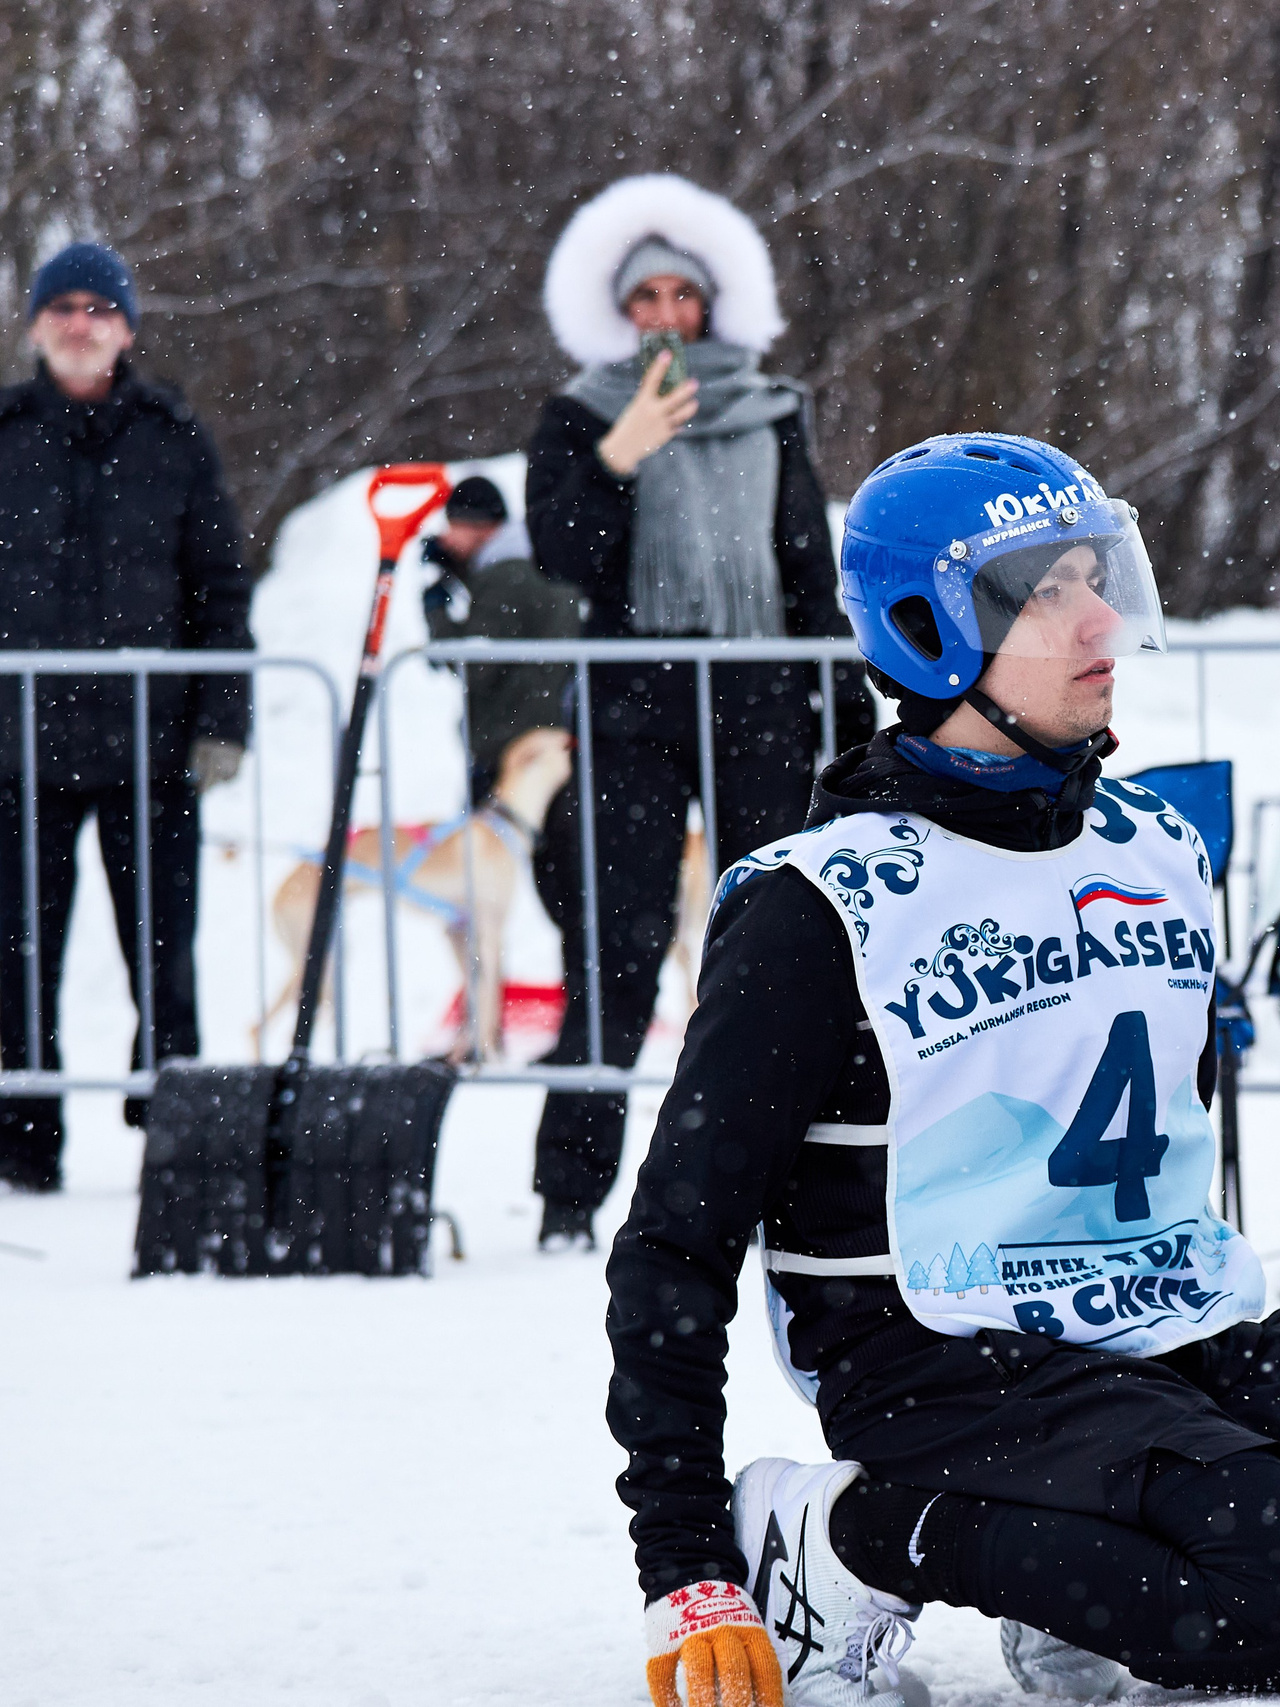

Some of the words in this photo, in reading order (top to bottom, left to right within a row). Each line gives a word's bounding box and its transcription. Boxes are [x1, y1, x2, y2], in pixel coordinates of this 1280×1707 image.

[981, 518, 1052, 547] МУРМАНСК
[917, 1032, 968, 1060] RUSSIA,
[969, 1006, 1026, 1036] MURMANSK
[1026, 992, 1072, 1014] REGION
[1048, 1010, 1170, 1222] 4
[1002, 1259, 1045, 1280] ДЛЯ
[1005, 1282, 1042, 1296] КТО
[1043, 1269, 1104, 1290] ЗНАЕТ
